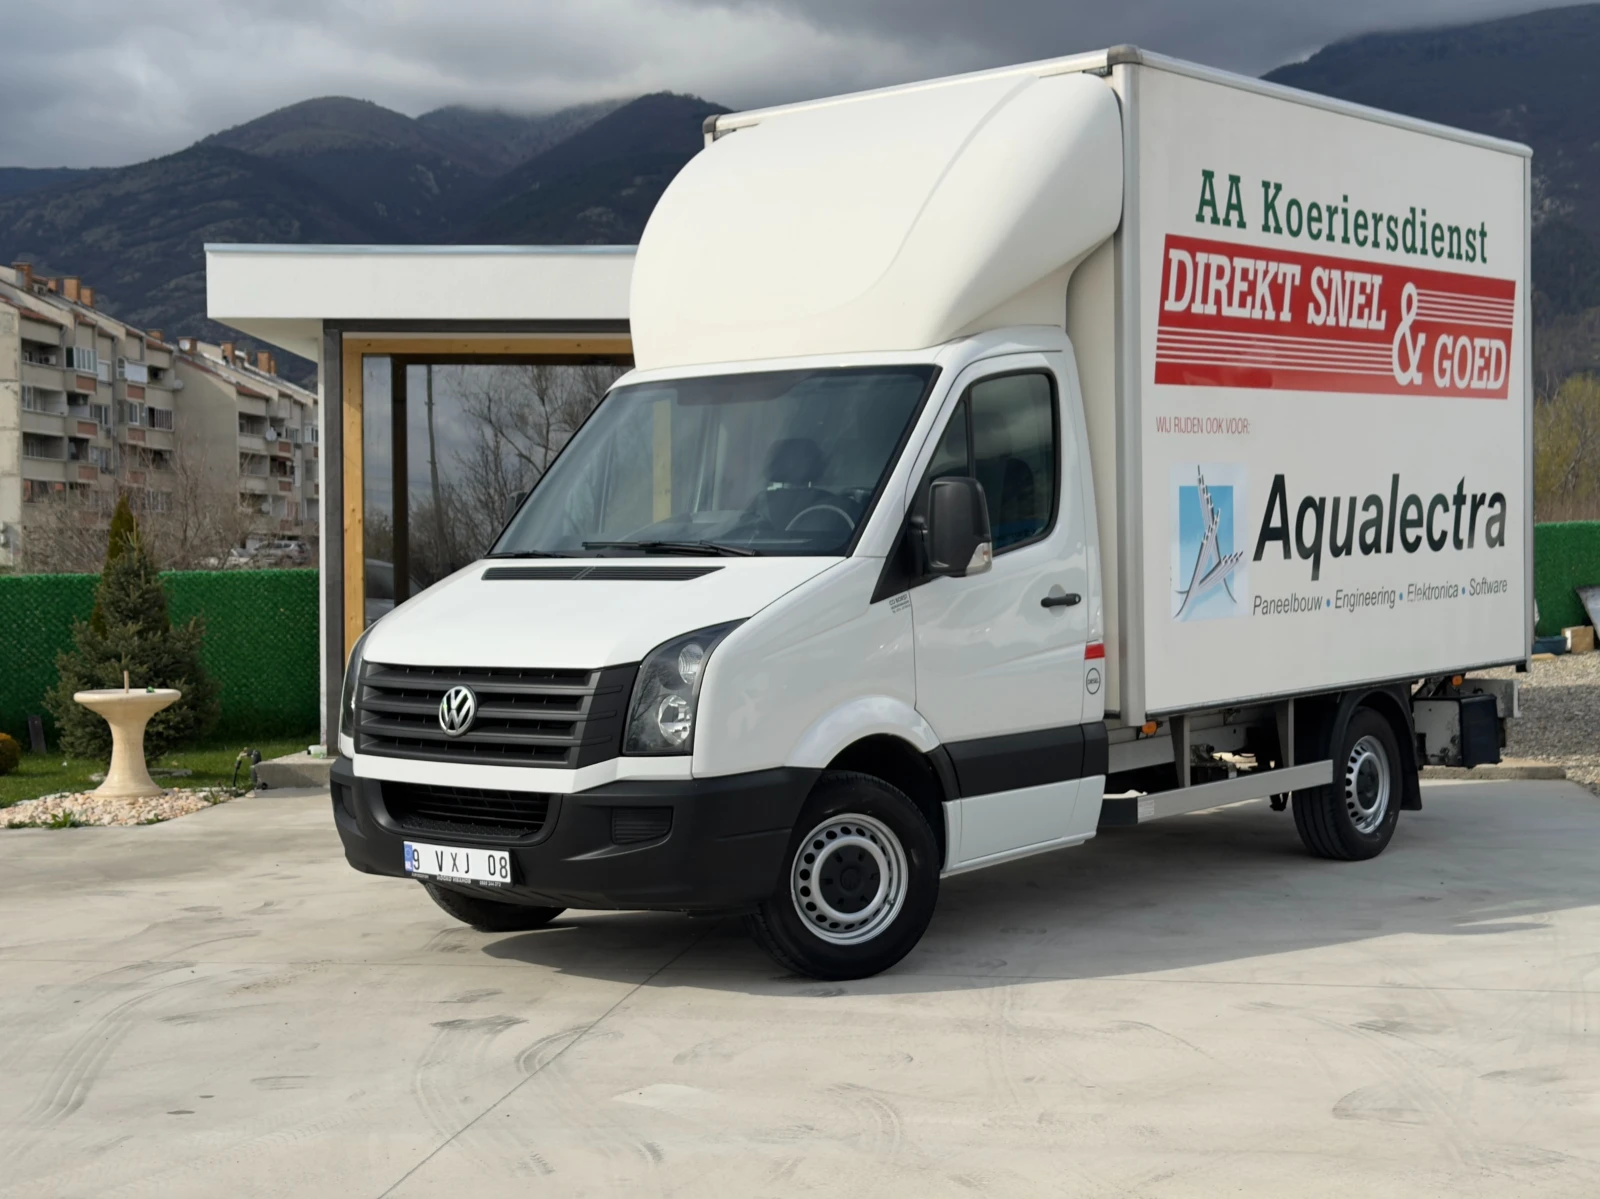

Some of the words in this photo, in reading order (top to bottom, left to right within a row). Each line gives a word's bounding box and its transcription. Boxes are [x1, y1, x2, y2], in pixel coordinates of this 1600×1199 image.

[1195, 169, 1247, 229] AA
[1261, 180, 1488, 264] Koeriersdienst
[1164, 248, 1301, 322] DIREKT
[1307, 266, 1387, 330] SNEL
[1433, 333, 1507, 389] GOED
[1156, 416, 1171, 433] WIJ
[1174, 416, 1203, 434] RIJDEN
[1206, 417, 1224, 434] OOK
[1253, 473, 1507, 581] Aqualectra
[1253, 592, 1323, 616] Paneelbouw
[1335, 588, 1396, 613] Engineering
[1407, 581, 1459, 602] Elektronica
[1469, 577, 1508, 596] Software
[412, 849, 420, 870] 9
[488, 854, 508, 879] 08
